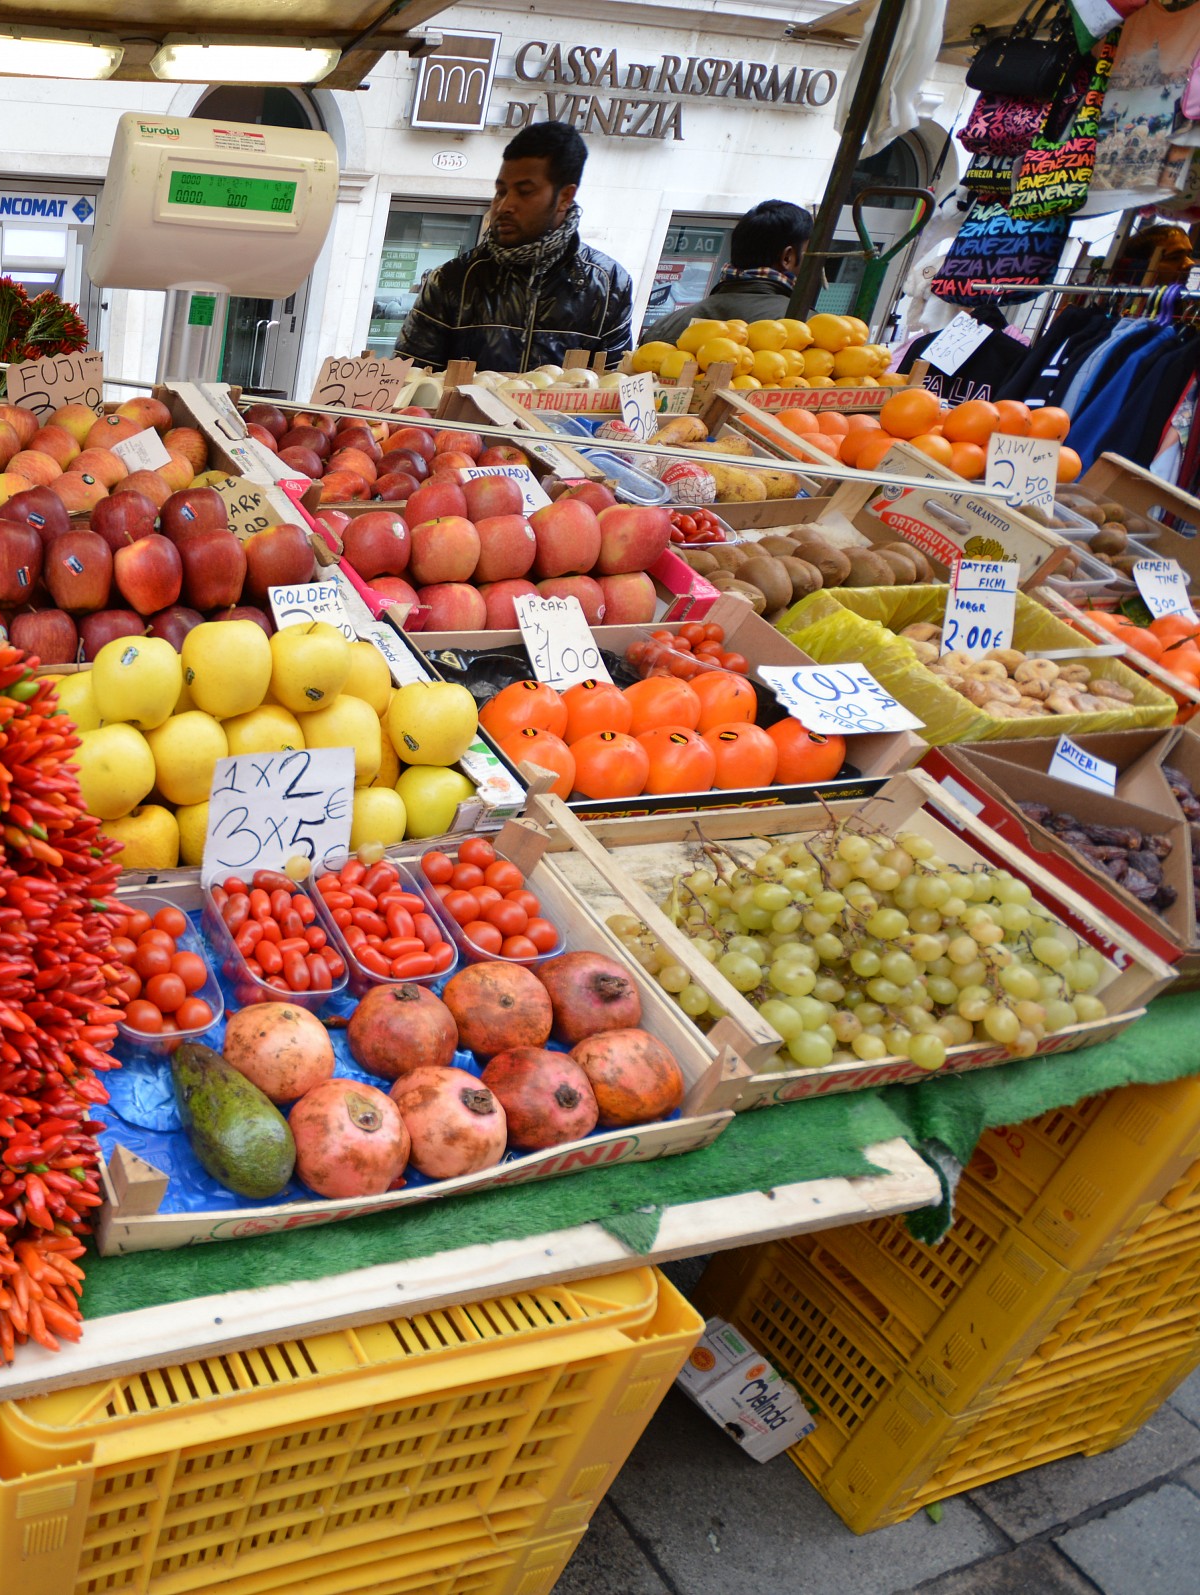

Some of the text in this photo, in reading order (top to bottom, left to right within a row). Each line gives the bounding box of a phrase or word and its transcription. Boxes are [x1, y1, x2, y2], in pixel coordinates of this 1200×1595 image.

[514, 40, 619, 88] CASSA
[657, 54, 837, 107] RISPARMIO
[543, 91, 685, 140] VENEZIA
[140, 125, 180, 136] Eurobil
[967, 169, 993, 178] VENEZIA
[1016, 169, 1068, 191] VENEZIA
[955, 235, 1030, 256] VENEZIA
[19, 358, 85, 393] FUJI
[326, 360, 392, 382] ROYAL
[621, 378, 645, 399] PERE
[764, 390, 886, 408] PIRACCINI
[536, 392, 589, 411] FRUTTA
[994, 437, 1036, 457] KIWI
[966, 500, 1011, 533] GARANTITO
[887, 514, 959, 560] ORTOFRUTTA
[960, 561, 1004, 573] DATTERI
[1136, 560, 1171, 572] CLEMEN
[978, 577, 1006, 589] FICHI
[1155, 574, 1180, 585] TINE
[273, 587, 339, 606] GOLDEN
[856, 676, 898, 711] UVA
[1060, 740, 1098, 772] DATTERI
